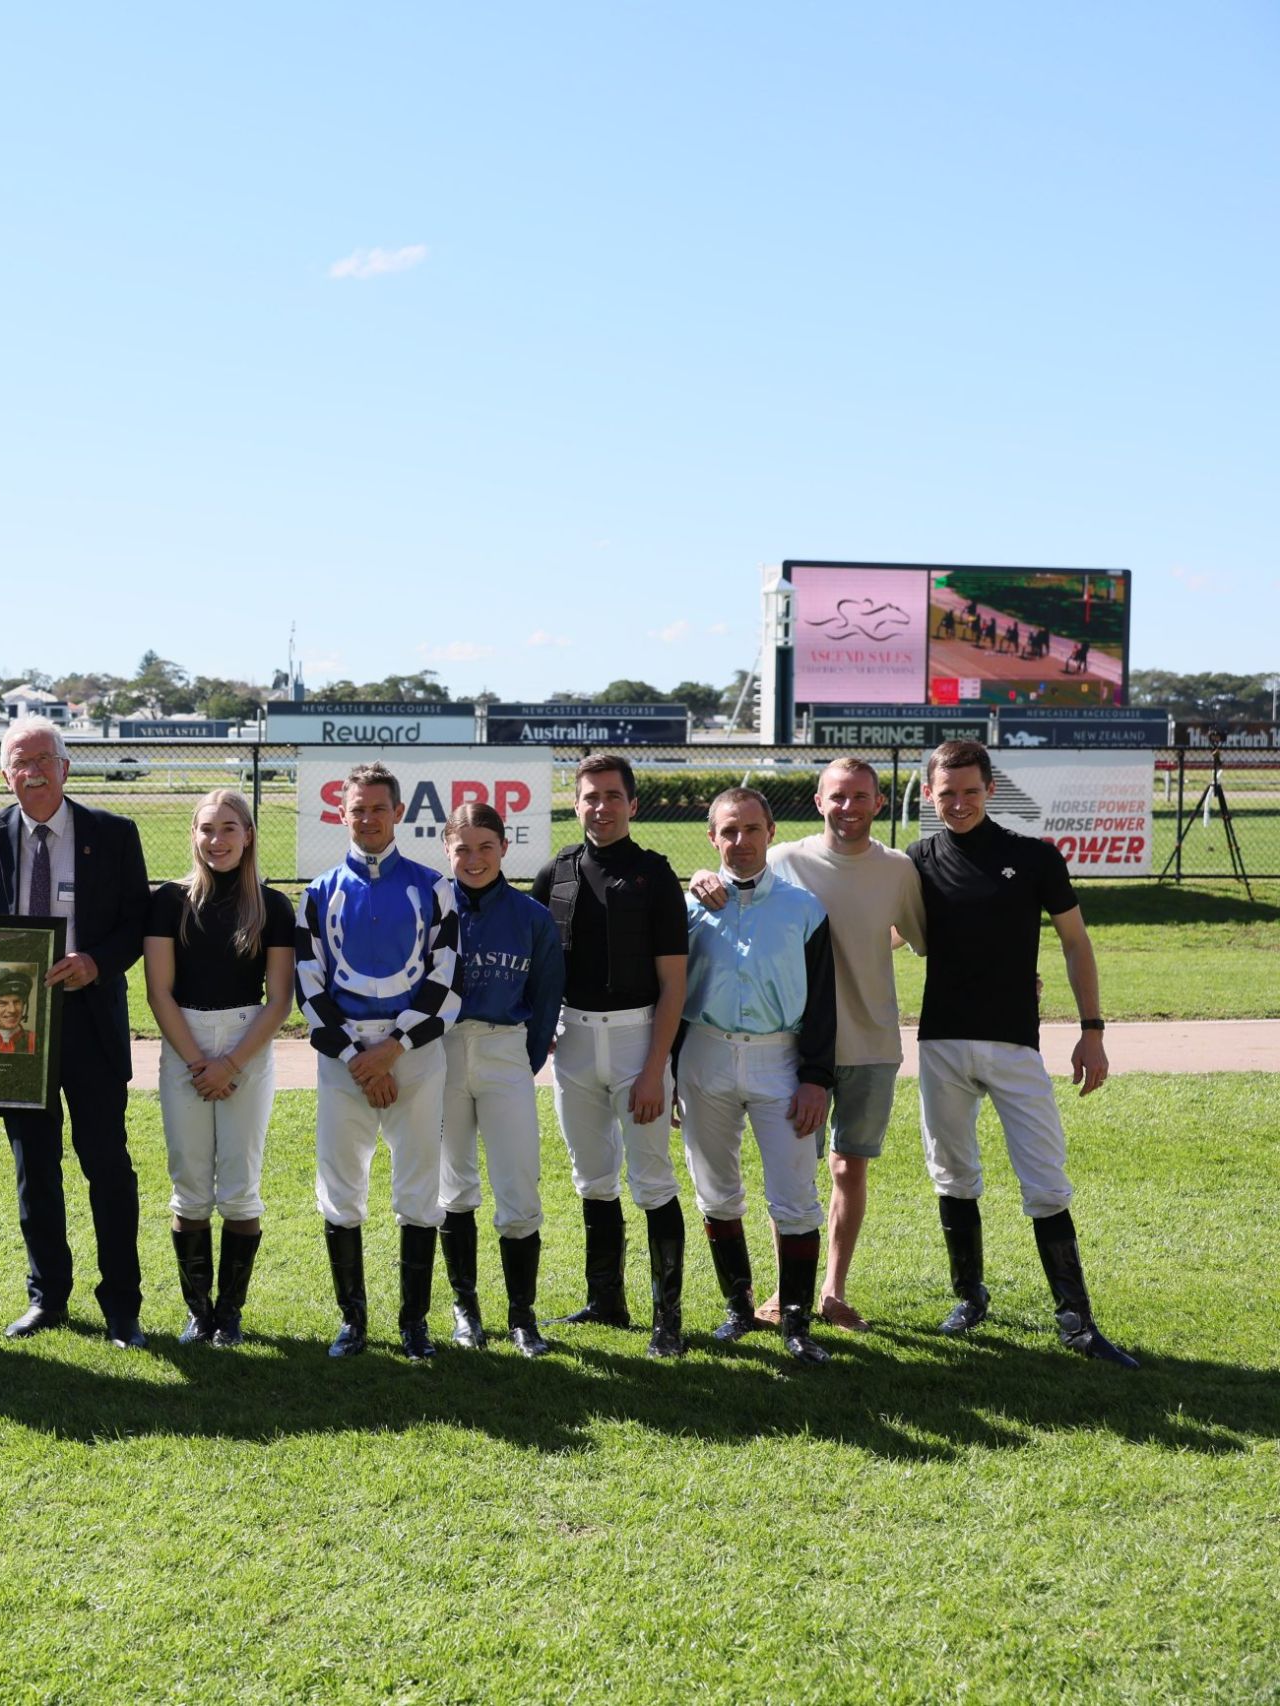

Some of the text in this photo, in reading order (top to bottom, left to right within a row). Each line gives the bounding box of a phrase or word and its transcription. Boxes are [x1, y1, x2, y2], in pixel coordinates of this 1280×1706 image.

[302, 704, 442, 713] NEWCASTLE RACECOURSE
[522, 706, 655, 716] NEWCASTLE RACECOURSE
[843, 708, 962, 717] NEWCASTLE RACECOURSE
[1026, 709, 1141, 718] NEWCASTLE RACECOURSE
[140, 727, 209, 737] NEWCASTLE
[322, 721, 421, 743] Reward
[520, 723, 609, 740] Australian
[822, 726, 925, 744] THE PRINCE
[1074, 731, 1145, 741] NEW ZEALAND
[1051, 800, 1145, 813] HORSEPOWER
[1043, 817, 1145, 831] HORSEPOWER
